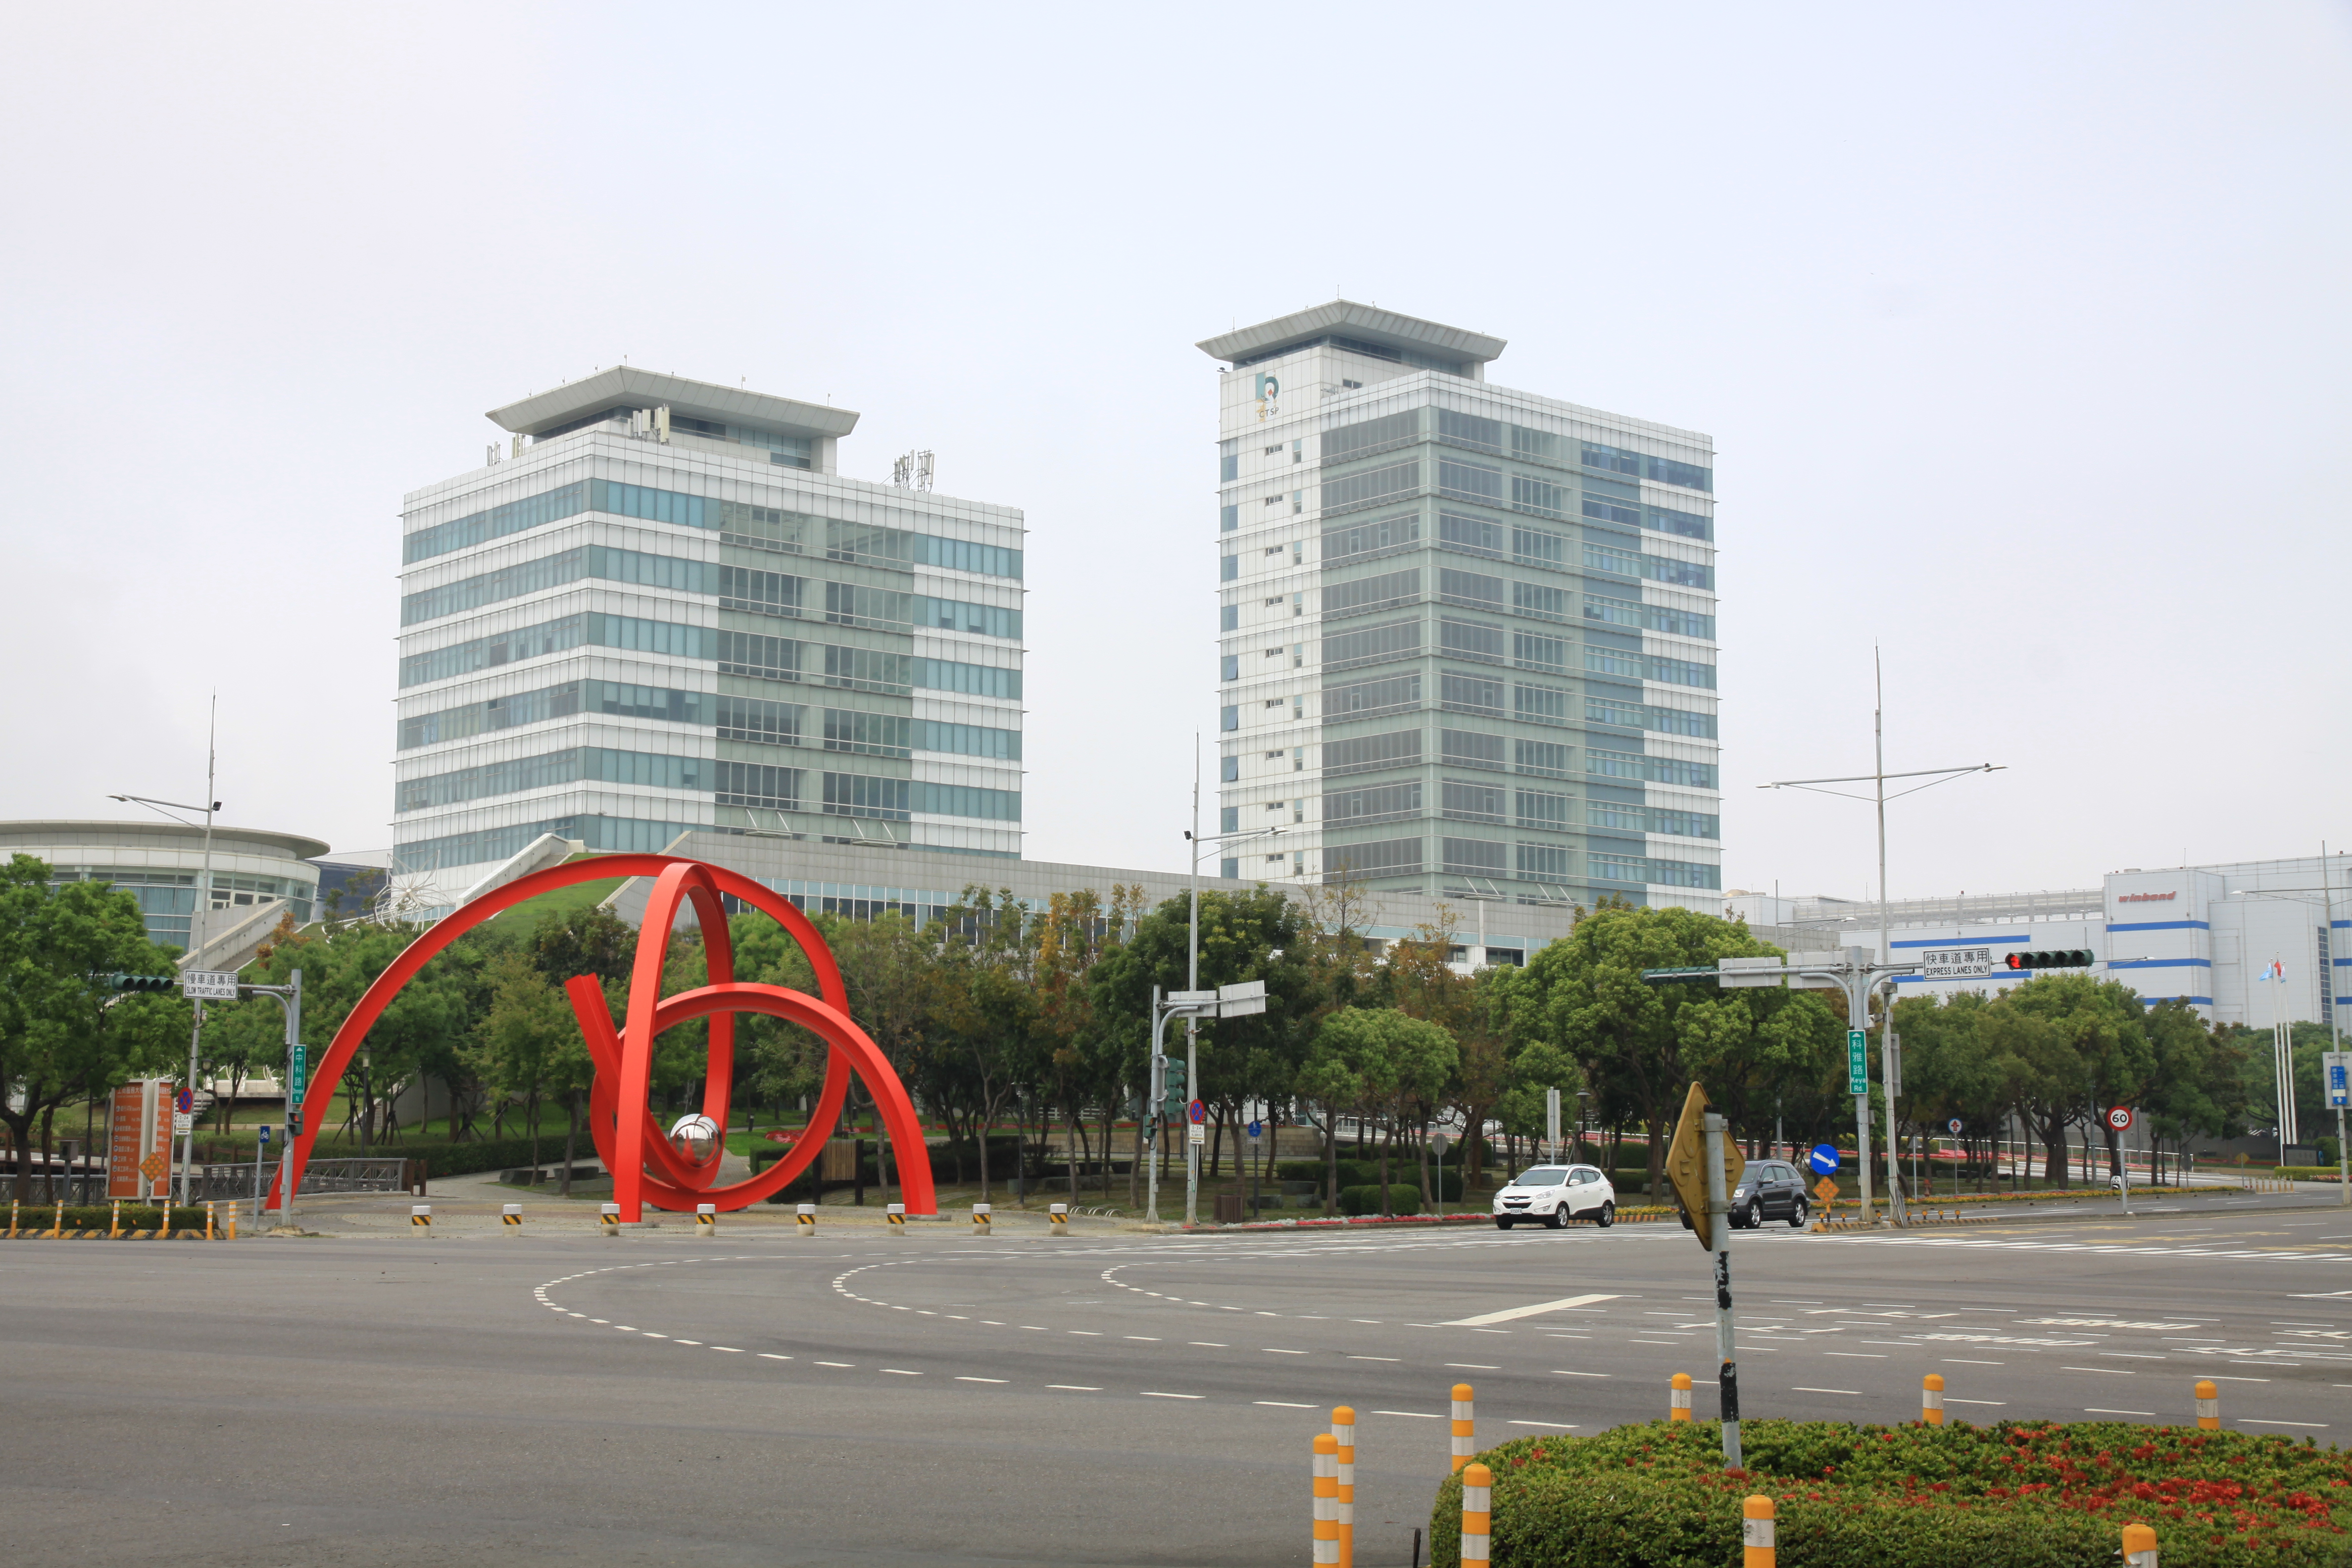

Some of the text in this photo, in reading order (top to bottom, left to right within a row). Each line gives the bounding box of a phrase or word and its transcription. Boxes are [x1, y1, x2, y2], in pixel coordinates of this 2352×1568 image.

[1259, 407, 1279, 418] CTSP
[2119, 891, 2176, 902] winbond
[1926, 950, 1988, 965] 快車道專用
[1926, 965, 1988, 976] EXPRESS LANES ONLY
[187, 973, 236, 986] 慢車道專用
[197, 987, 213, 995] TRAFFIC
[1852, 1039, 1863, 1075] 科雅路
[294, 1053, 303, 1086] 中科路
[2112, 1114, 2127, 1123] 60
